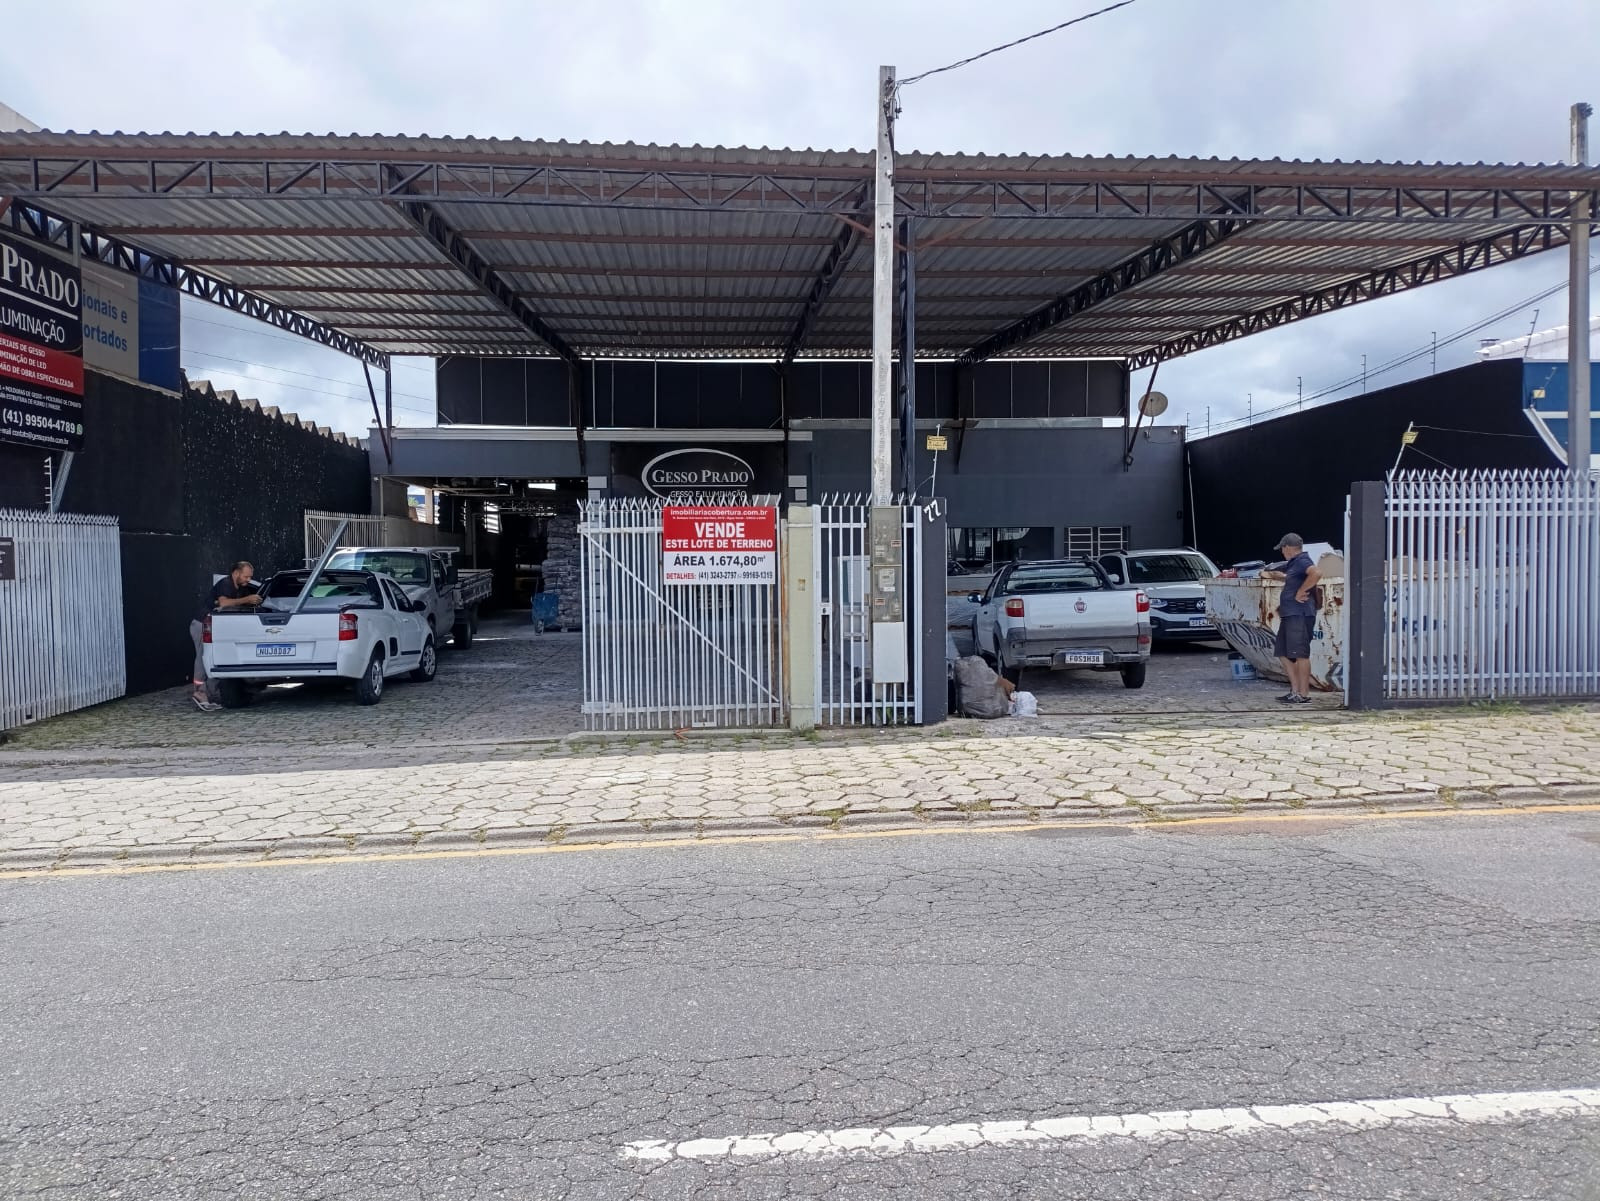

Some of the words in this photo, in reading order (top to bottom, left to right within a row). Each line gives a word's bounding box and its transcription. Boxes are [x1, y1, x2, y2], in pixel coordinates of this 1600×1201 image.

[0, 243, 79, 308] PRADO
[83, 288, 118, 321] ionais
[121, 310, 128, 324] e
[0, 306, 65, 343] UMINAÇÃO
[0, 337, 18, 350] ERIAIS
[20, 343, 28, 352] DE
[28, 346, 46, 358] GESSO
[83, 323, 128, 352] ortados
[29, 358, 36, 367] DE
[37, 361, 46, 370] LED
[12, 366, 20, 374] DE
[20, 368, 36, 378] OBRA
[36, 372, 74, 388] ESPECIALIZADA
[3, 408, 22, 426] (41)
[25, 414, 76, 434] 99504-4789
[652, 470, 698, 483] GESSO
[702, 470, 748, 483] PRADO
[923, 499, 942, 522] 77
[694, 522, 745, 538] VENDE
[666, 539, 688, 548] ESTE
[691, 539, 714, 548] LOTE
[716, 539, 728, 548] DE
[731, 539, 773, 548] TERRENO
[674, 554, 706, 566] ÁREA
[698, 572, 709, 580] (41)
[710, 572, 737, 580] 3243-2797
